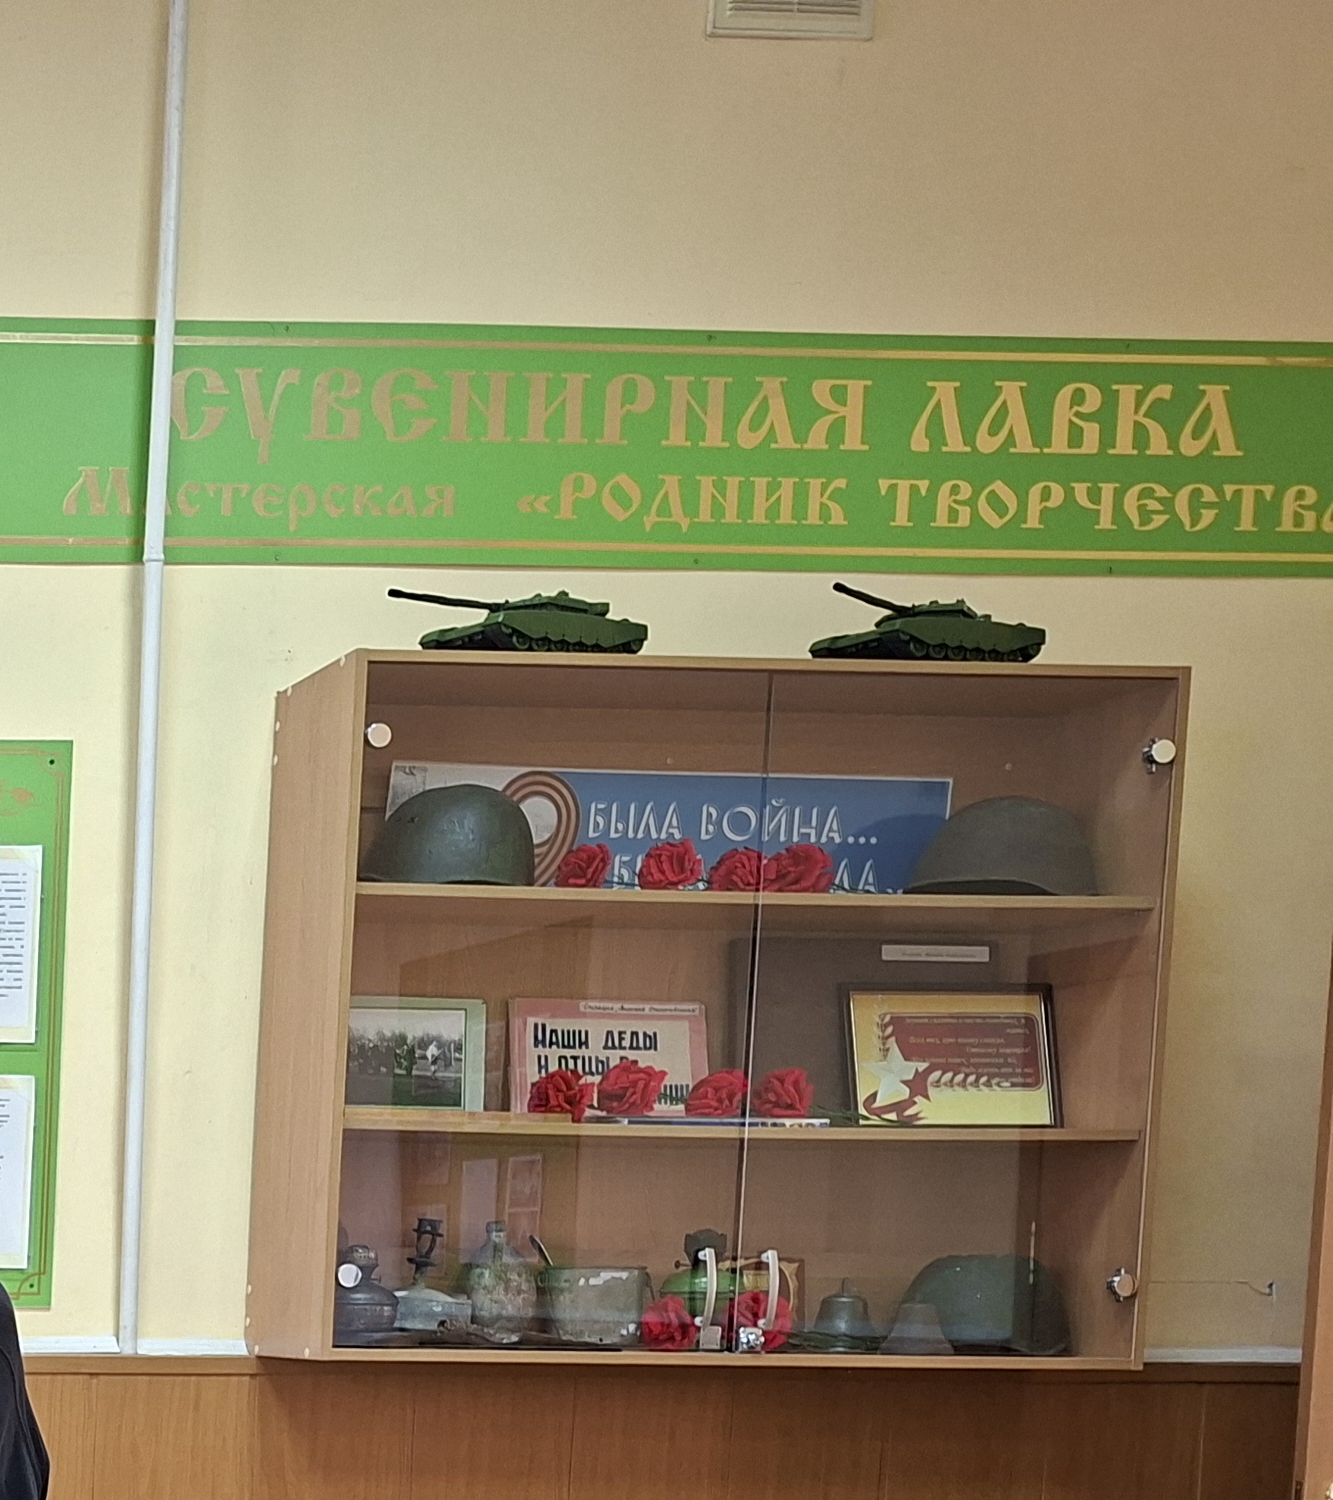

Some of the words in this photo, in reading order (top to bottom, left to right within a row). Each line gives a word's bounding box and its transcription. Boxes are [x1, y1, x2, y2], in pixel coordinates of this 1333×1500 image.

[909, 378, 1245, 457] ЛАВКА
[62, 466, 456, 532] Мстерская
[878, 478, 1333, 535] ТВОРЧЕСТВ
[588, 800, 683, 841] БЫЛА
[699, 797, 879, 846] ВОЙНА...
[602, 1029, 659, 1053] ДЕДЫ
